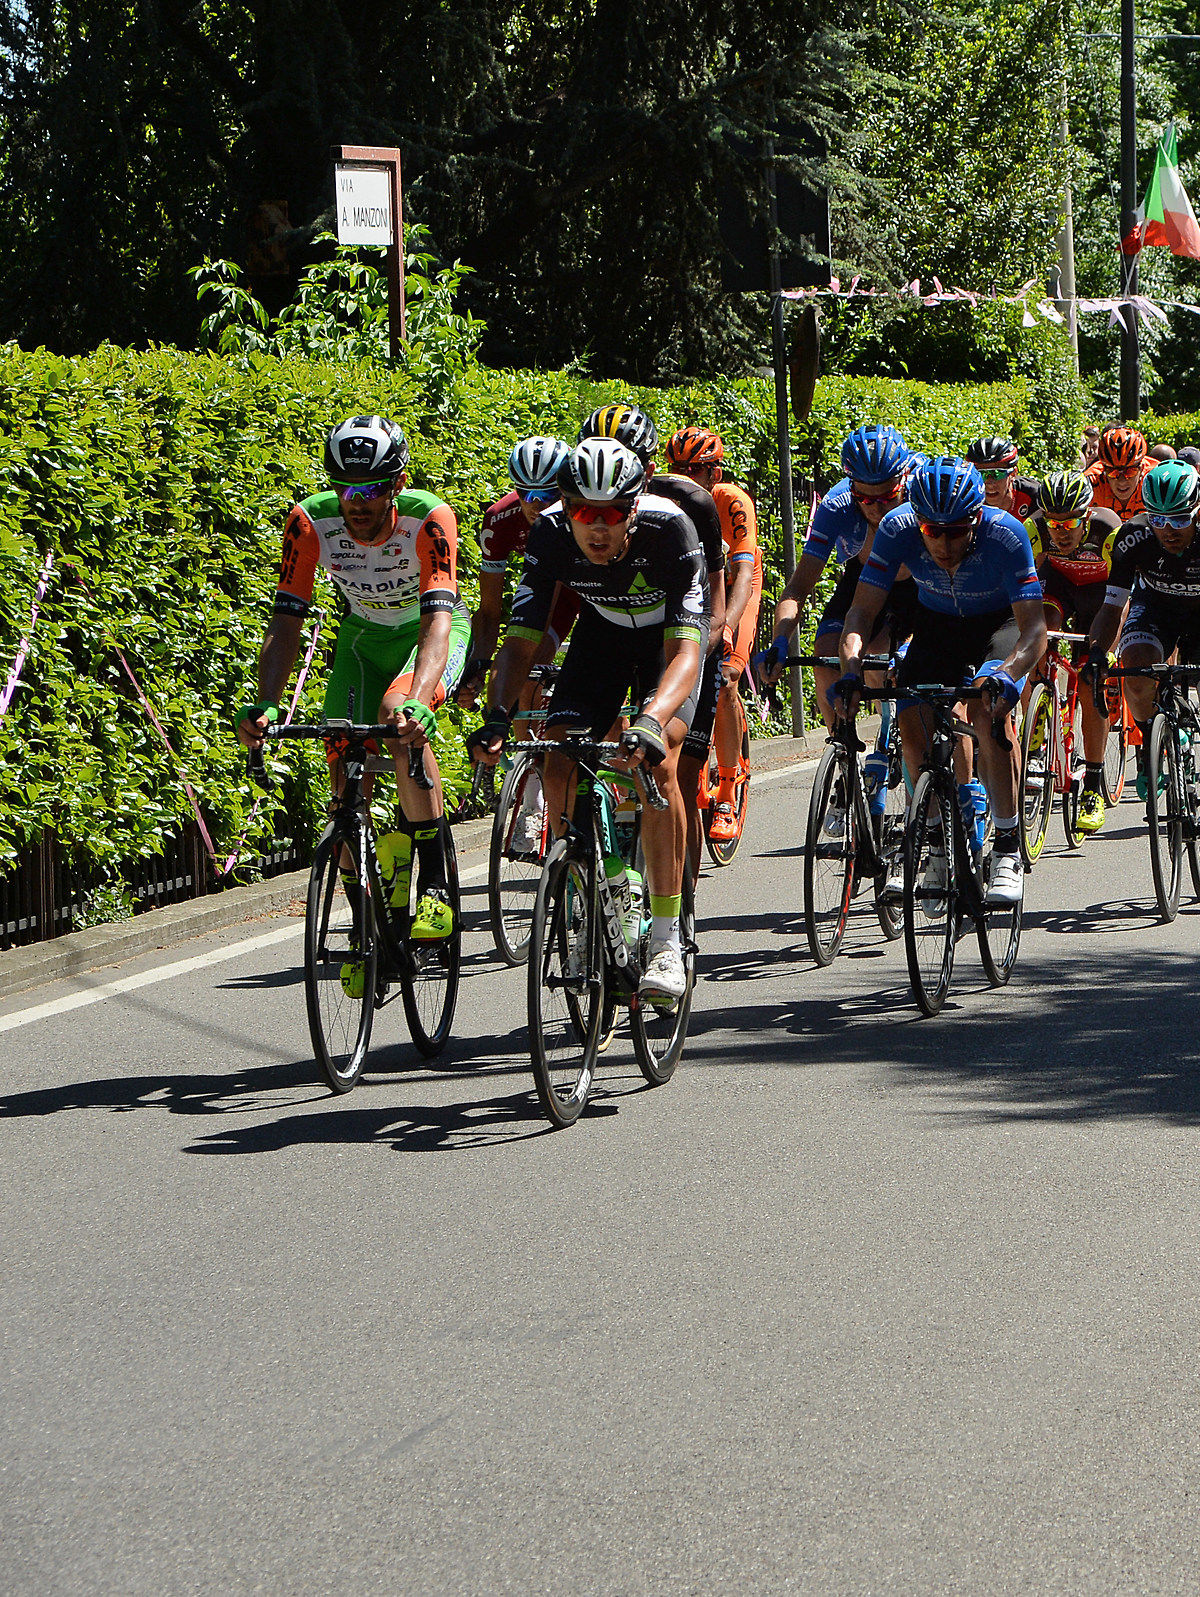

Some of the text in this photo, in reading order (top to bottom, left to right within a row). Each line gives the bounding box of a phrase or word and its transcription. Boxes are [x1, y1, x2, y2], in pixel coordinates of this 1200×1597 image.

[340, 179, 354, 192] VIA
[728, 499, 748, 539] CCC
[1117, 526, 1154, 553] BORA
[569, 580, 603, 588] Deloitte
